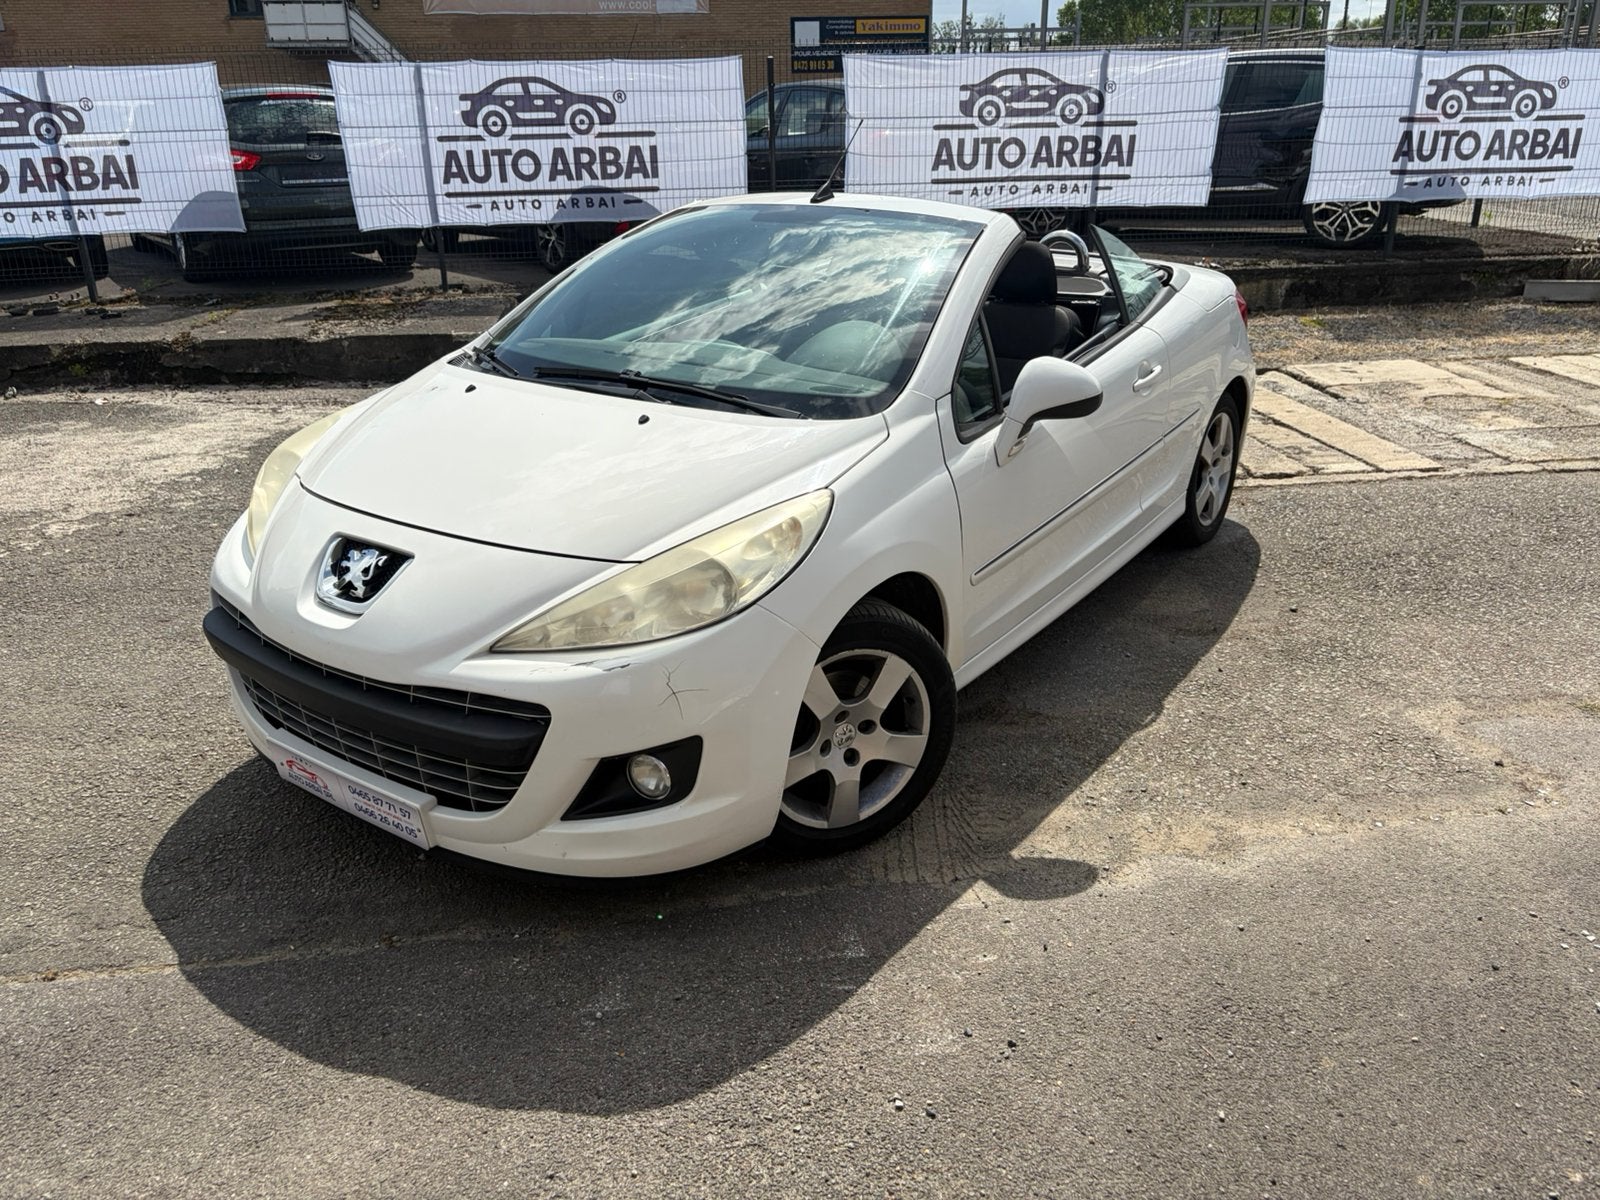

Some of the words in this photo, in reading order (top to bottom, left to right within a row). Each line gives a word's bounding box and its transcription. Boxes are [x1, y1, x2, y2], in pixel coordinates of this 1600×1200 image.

[860, 21, 921, 31] Yakimmo
[931, 136, 1027, 172] AUTO
[1030, 133, 1137, 169] ARBAI
[1392, 129, 1482, 162] AUTO
[1482, 127, 1584, 161] ARBAI
[18, 154, 140, 194] ARBAI
[443, 148, 542, 185] AUTO
[549, 145, 660, 182] ARBAI
[970, 185, 1019, 197] AUTO
[1031, 183, 1088, 195] ARBAI
[1424, 176, 1470, 189] AUTO
[1481, 175, 1534, 187] ARBAI
[490, 198, 542, 212] AUTO
[556, 195, 617, 210] ARBAI
[31, 208, 97, 223] ARBAI
[385, 801, 398, 813] 71
[399, 807, 411, 819] 57
[392, 821, 404, 832] 40
[405, 826, 418, 839] 05
